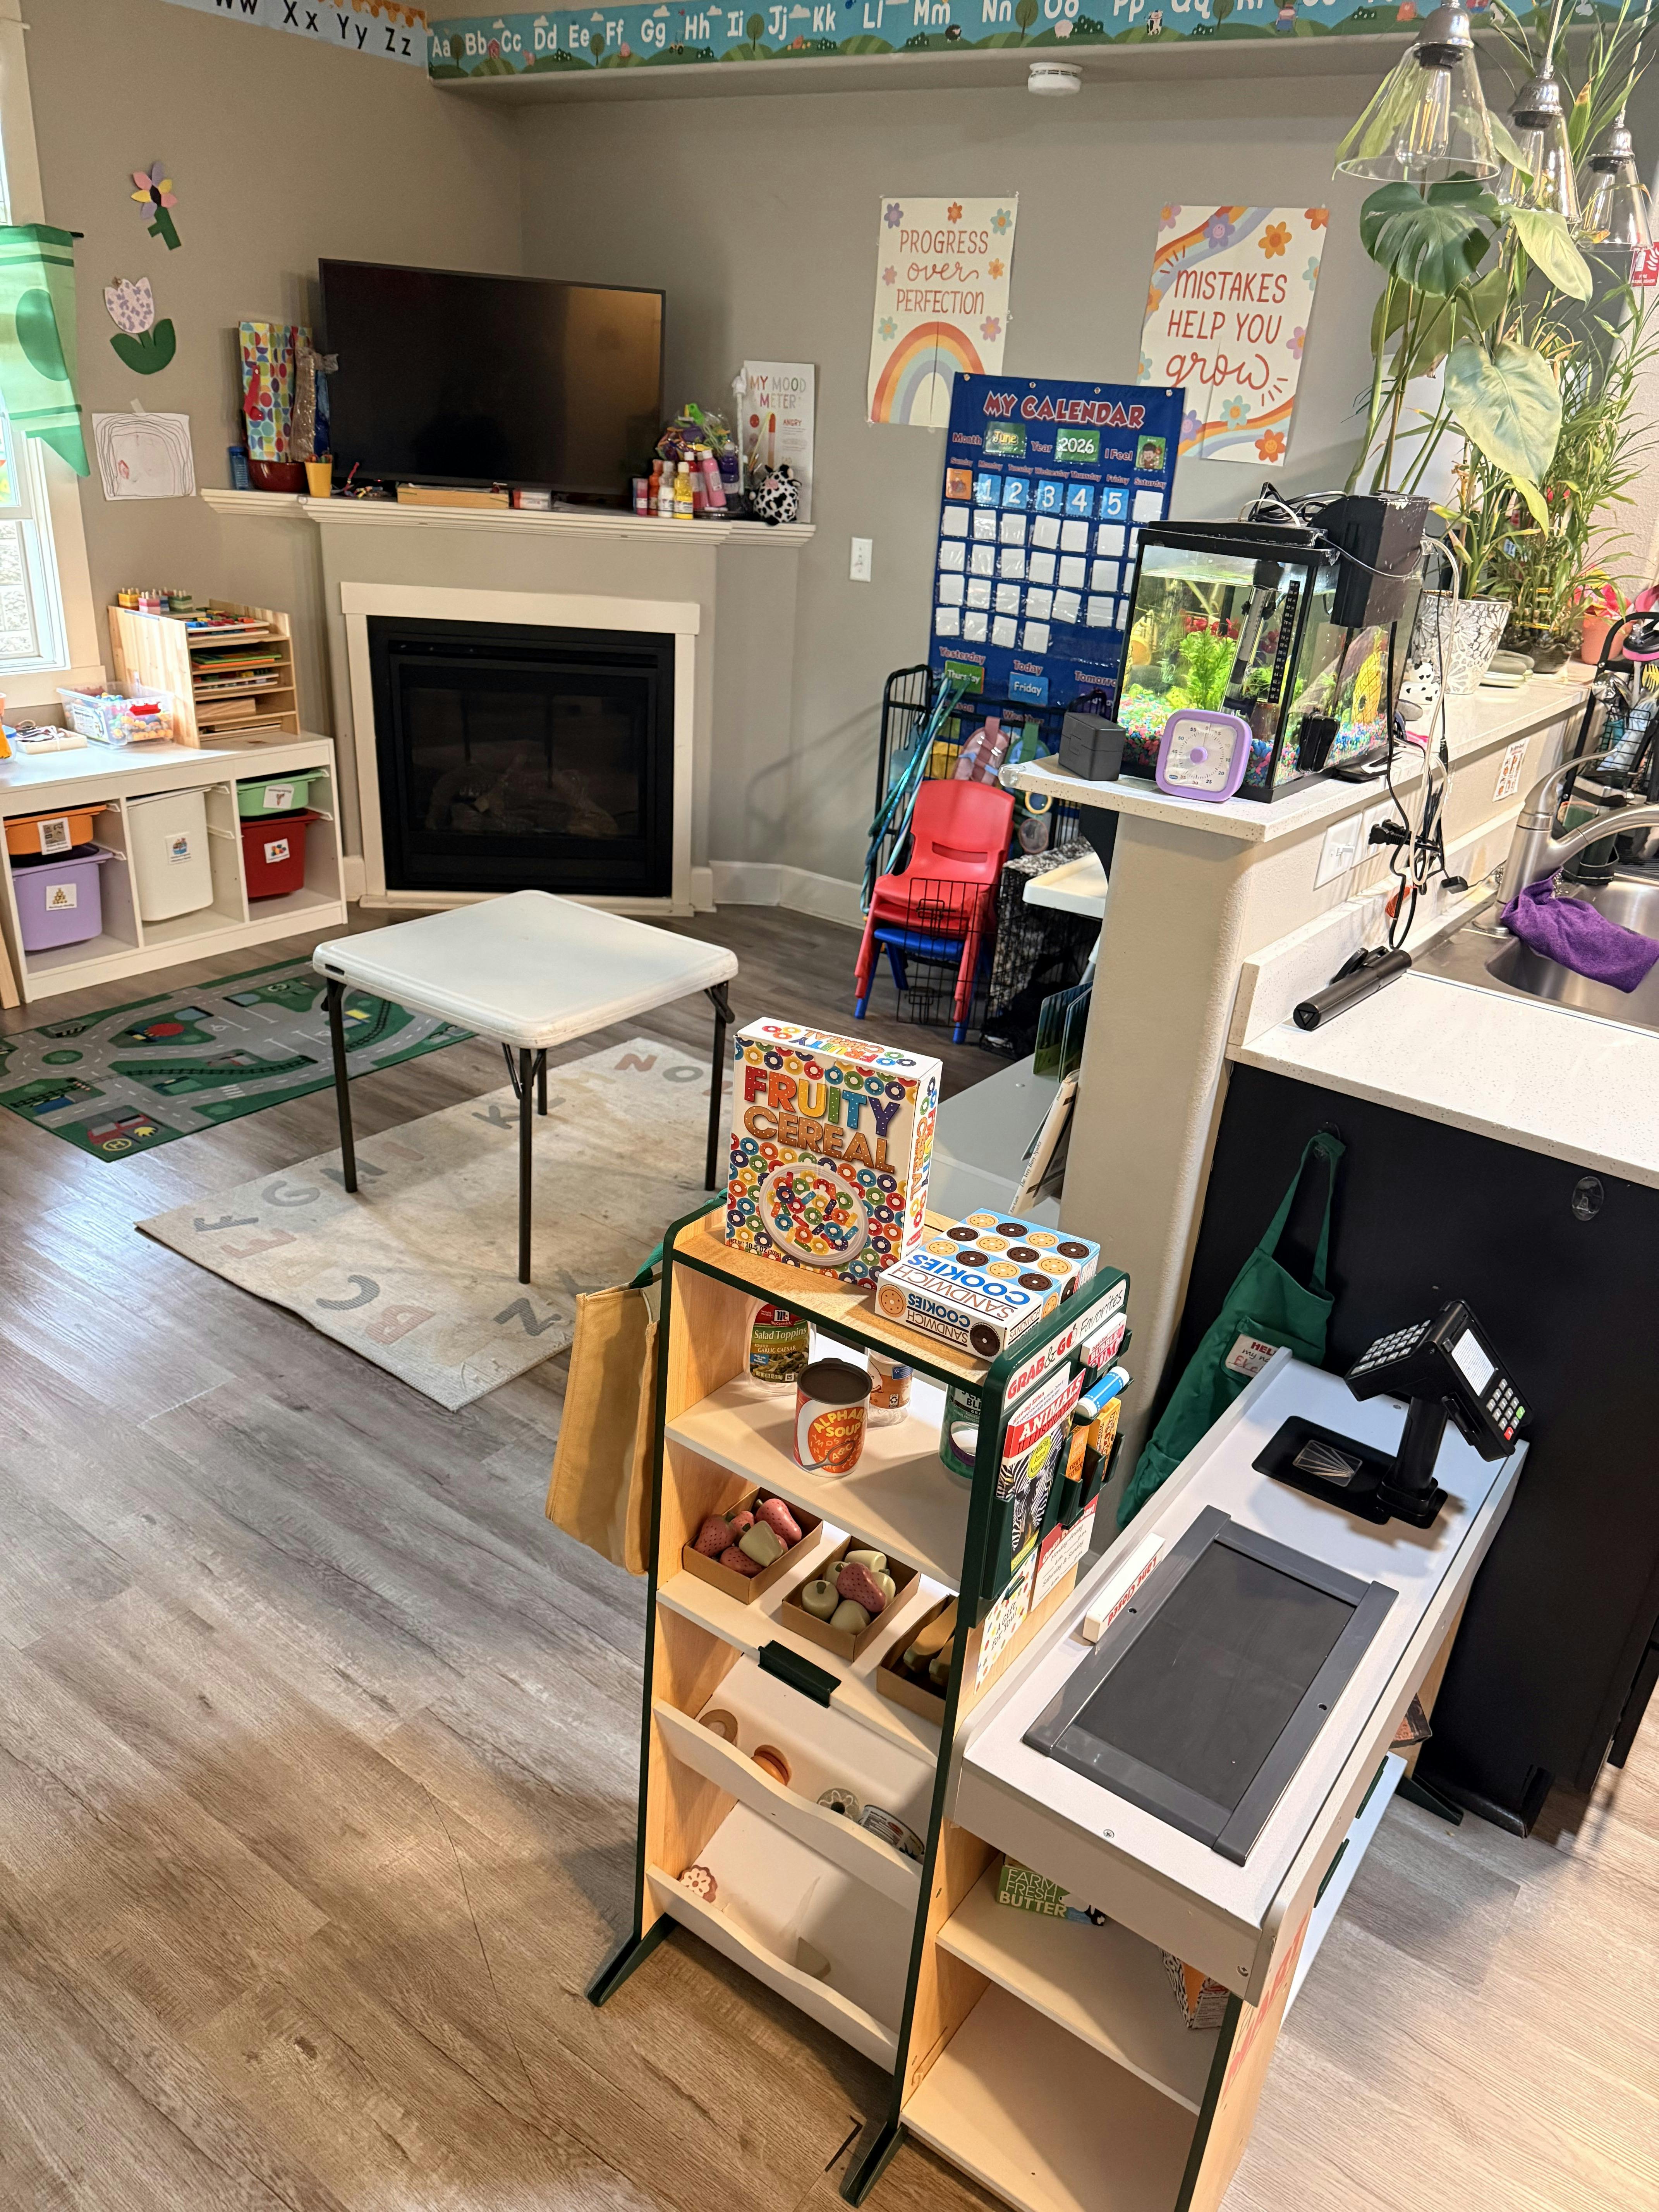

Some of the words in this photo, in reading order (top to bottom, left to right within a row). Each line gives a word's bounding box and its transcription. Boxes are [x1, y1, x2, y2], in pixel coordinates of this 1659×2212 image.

[432, 36, 451, 58] Aa
[465, 31, 487, 56] Bb
[501, 30, 521, 53] Cc
[534, 24, 557, 50] Dd
[568, 24, 590, 48] Ee
[606, 18, 624, 46] Ff
[641, 19, 666, 48] Gg
[685, 12, 710, 40] Hh
[727, 10, 744, 37] Ii
[768, 5, 787, 41] Jj
[813, 5, 836, 33] Kk
[863, 0, 883, 29] Ll
[913, 0, 950, 26] Mm
[982, 0, 1011, 22] Nn
[899, 229, 989, 254] PROGRESS
[907, 261, 979, 282] over
[1174, 270, 1288, 303] MISTAKES
[896, 289, 984, 314] PERFECTION
[1167, 309, 1226, 340] HELP
[1236, 313, 1283, 344] YOU
[750, 375, 768, 391] MY
[772, 376, 806, 393] MOOD
[1165, 352, 1270, 390] grow
[760, 392, 796, 409] METER
[983, 390, 1018, 418] MY
[1020, 395, 1146, 429] CALENDAR
[952, 432, 982, 446] Month
[992, 429, 1019, 445] June
[1030, 440, 1053, 453] Year
[1059, 437, 1094, 454] 2026
[1104, 448, 1109, 459] I
[1110, 449, 1133, 461] Feel
[1106, 474, 1130, 486] Friday
[1133, 477, 1167, 490] Saturday
[984, 478, 992, 501] 1
[1008, 481, 1023, 504] 2
[1043, 484, 1056, 508] 3
[1071, 488, 1087, 513] 4
[1107, 492, 1122, 515] 5
[939, 646, 986, 666] Yesterday
[1013, 659, 1044, 677] Today
[1074, 670, 1117, 687] Tomorro
[1013, 681, 1042, 697] Friday
[788, 1037, 879, 1063] FRUITY
[804, 1028, 885, 1054] CEREAL
[744, 1065, 901, 1137] FRUITY
[743, 1105, 895, 1175] CEREAL
[921, 1107, 936, 1187] FRUITY
[910, 1116, 928, 1201] CEREAL
[745, 1242, 758, 1250] 10.5
[891, 1266, 1015, 1319] SANDWICH
[907, 1254, 1031, 1306] COOKIES
[908, 1293, 970, 1328] COOKIES
[754, 1330, 774, 1340] Salad
[775, 1328, 807, 1341] Toppins
[907, 1308, 969, 1343] SANDWICH
[1008, 1308, 1041, 1341] SANDWICH
[1007, 1355, 1045, 1400] GRAB
[1044, 1346, 1057, 1369] &
[1079, 1290, 1123, 1338] Favorites
[1242, 1349, 1257, 1360] my
[1018, 1375, 1082, 1442] ANIMALS
[825, 1422, 861, 1437] SOUP
[832, 1443, 852, 1461] ABC
[1137, 1555, 1157, 1587] Lane
[1107, 1584, 1135, 1627] Closed
[1006, 1869, 1057, 1891] FARM
[1006, 1880, 1058, 1903] FRESH
[999, 1890, 1067, 1918] BUTTER
